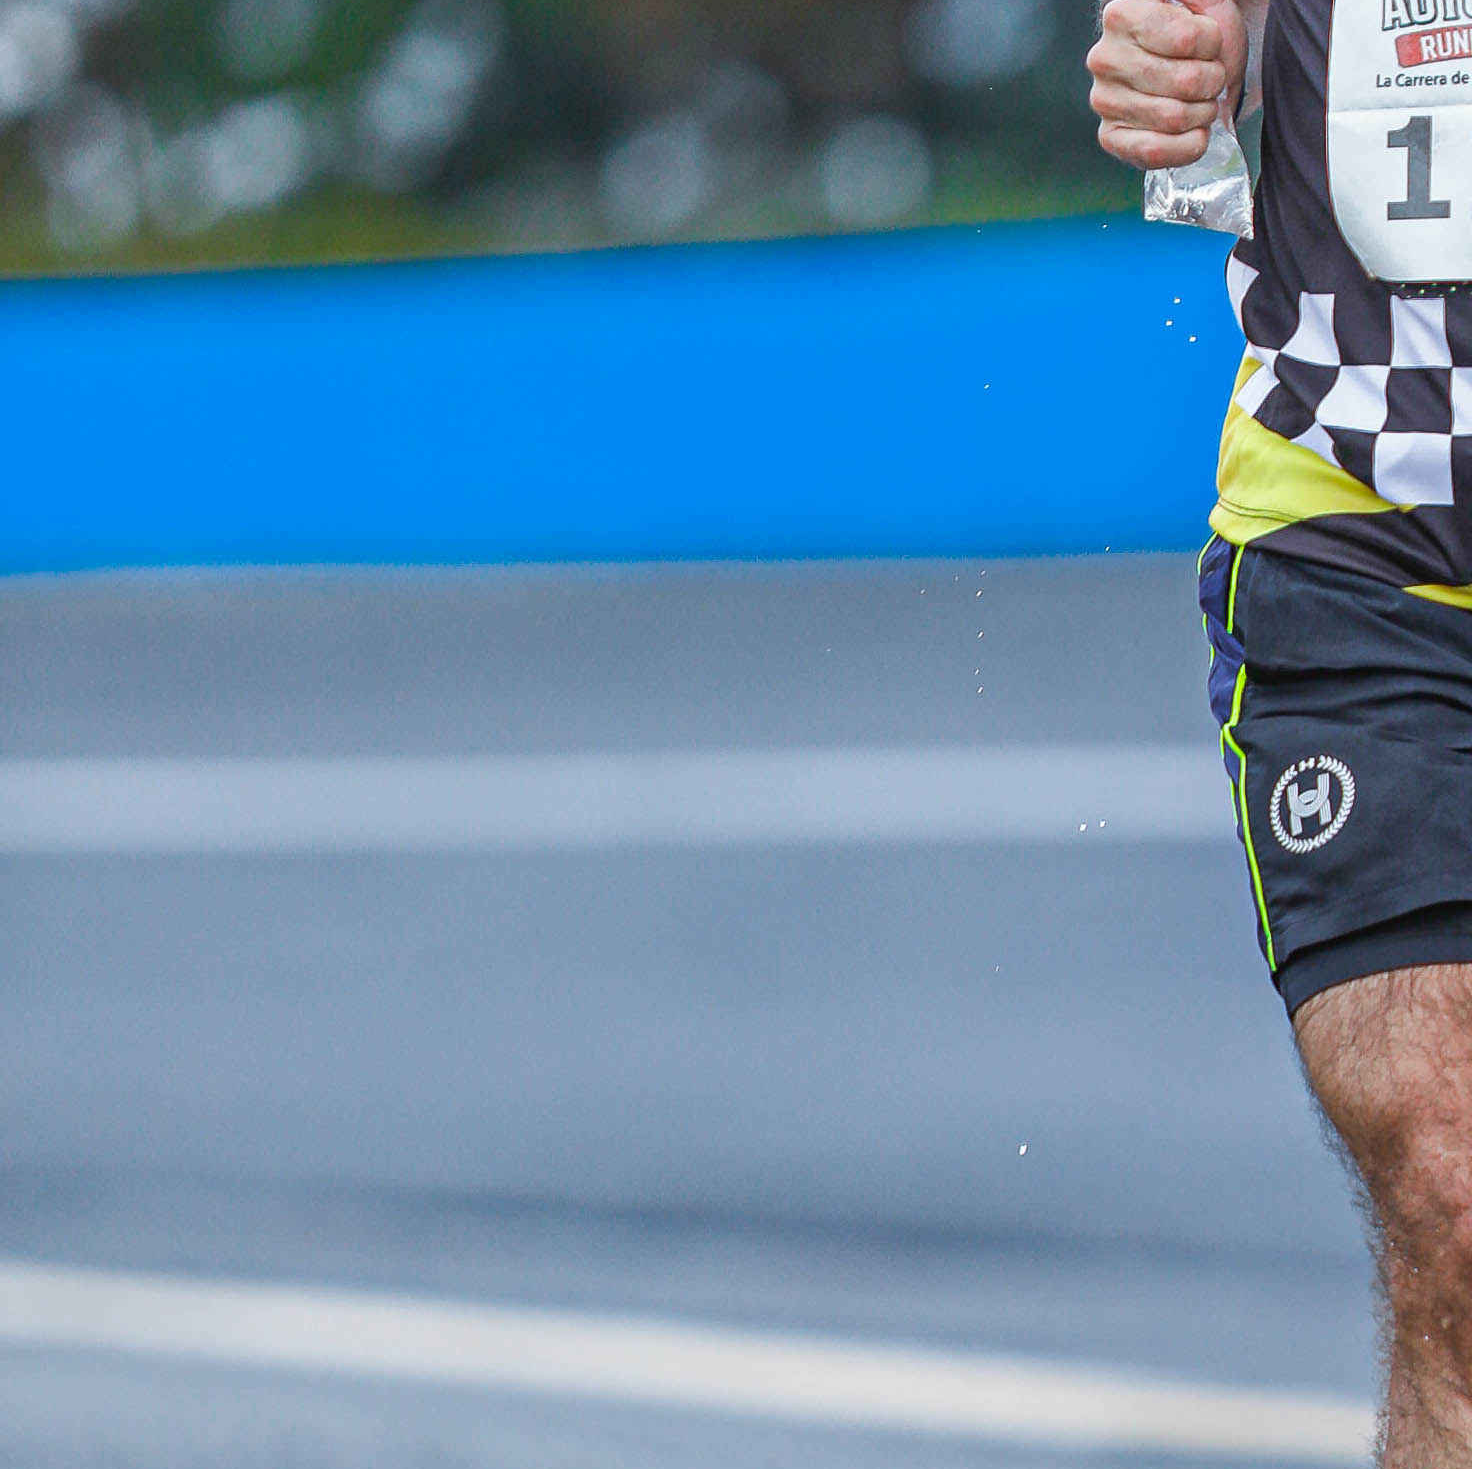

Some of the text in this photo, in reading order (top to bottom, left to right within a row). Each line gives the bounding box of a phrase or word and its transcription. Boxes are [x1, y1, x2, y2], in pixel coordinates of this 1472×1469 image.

[1376, 74, 1392, 88] La
[1395, 73, 1447, 87] Carrera
[1451, 70, 1470, 85] de
